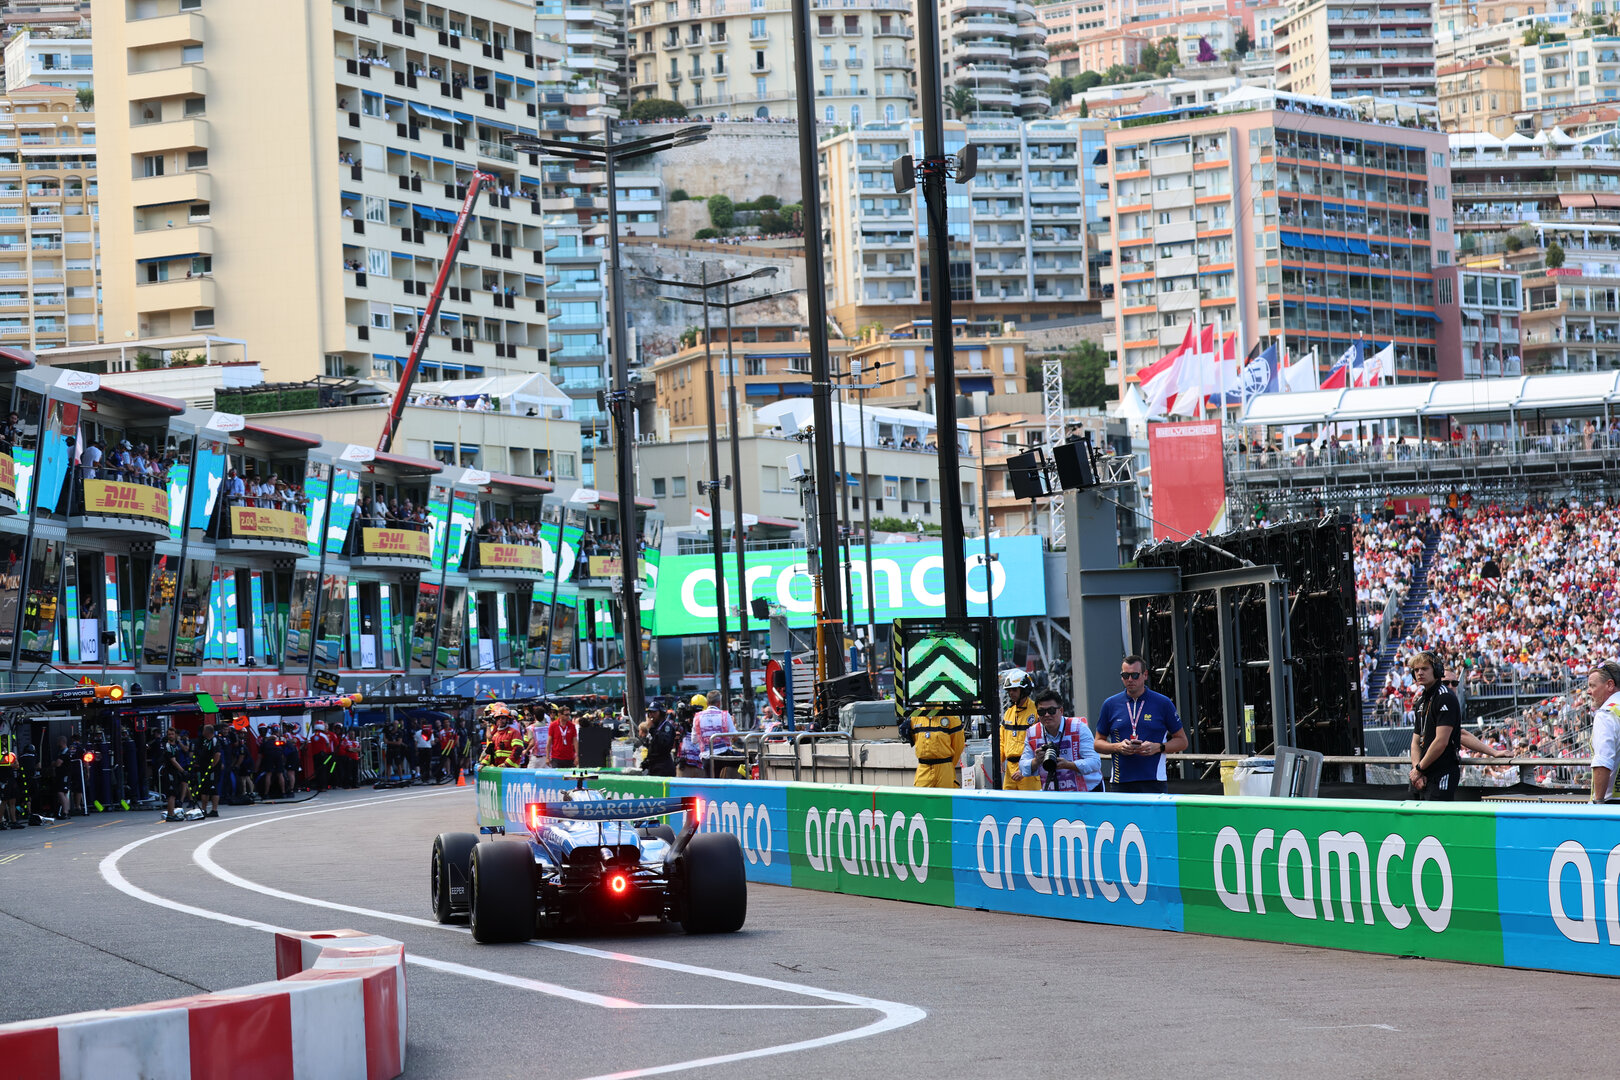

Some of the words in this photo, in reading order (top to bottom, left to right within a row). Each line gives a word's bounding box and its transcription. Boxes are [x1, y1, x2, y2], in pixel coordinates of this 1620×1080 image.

[98, 486, 142, 510] DHL
[374, 532, 409, 550] DHL
[489, 546, 521, 562] DHL
[598, 559, 622, 574] DH
[681, 553, 1006, 618] aramco
[583, 801, 666, 816] BARCLAYS
[690, 799, 772, 866] amco
[805, 806, 930, 884] aramco
[976, 814, 1148, 905] aramco
[1213, 826, 1454, 933] aramco
